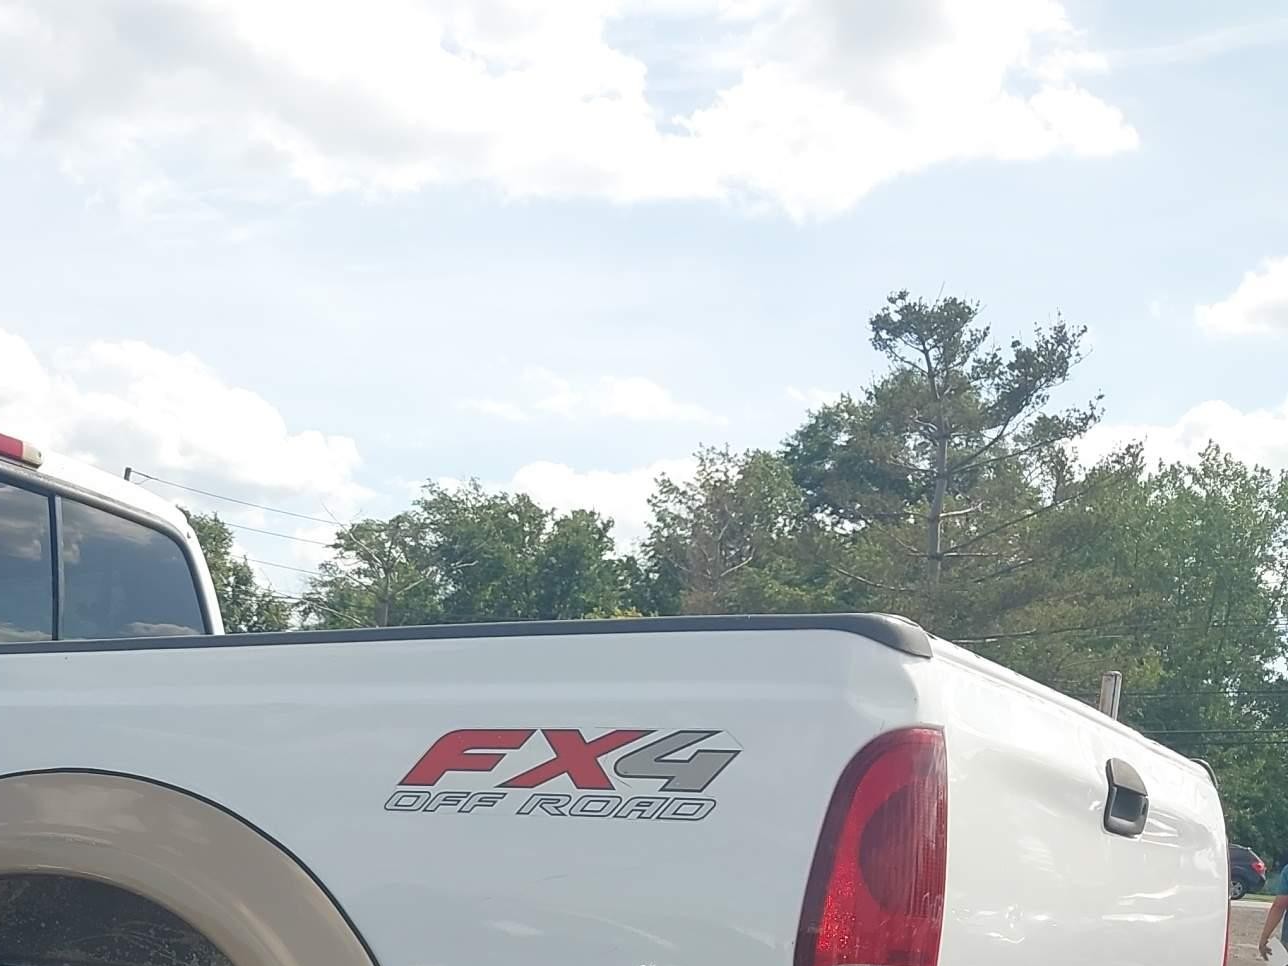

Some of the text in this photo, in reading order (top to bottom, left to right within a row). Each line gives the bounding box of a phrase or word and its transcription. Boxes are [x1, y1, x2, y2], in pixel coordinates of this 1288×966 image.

[396, 728, 743, 792] FX4
[383, 791, 717, 821] OFF ROAD
